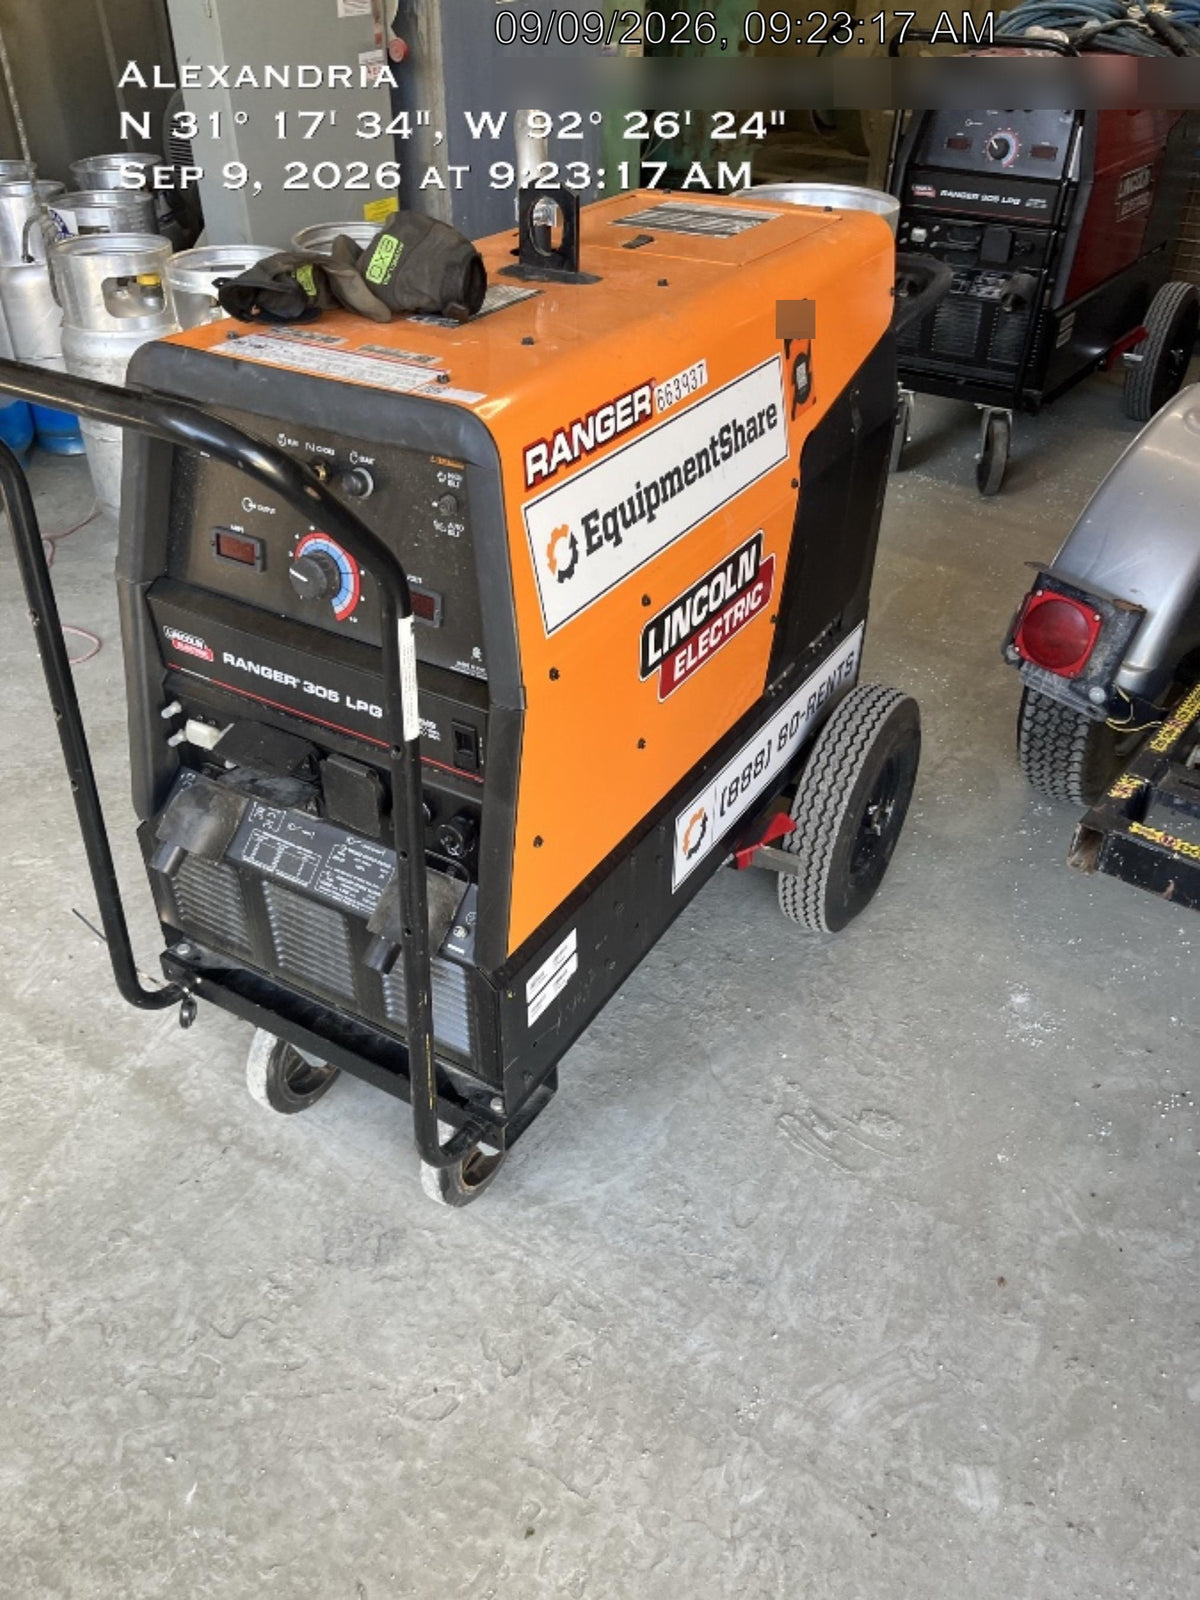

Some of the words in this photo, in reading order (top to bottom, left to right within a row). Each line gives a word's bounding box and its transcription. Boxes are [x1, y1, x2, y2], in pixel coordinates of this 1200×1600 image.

[525, 384, 653, 487] RANGER
[657, 362, 705, 412] 663937
[581, 402, 778, 557] EquipmentShare
[648, 543, 757, 668] LINCOLN
[672, 582, 764, 683] ELECTRIC
[222, 652, 302, 690] RANGER
[303, 680, 341, 704] 305
[345, 695, 384, 719] LPG
[719, 738, 773, 817] (888)
[776, 650, 855, 753] 80-RENTS
